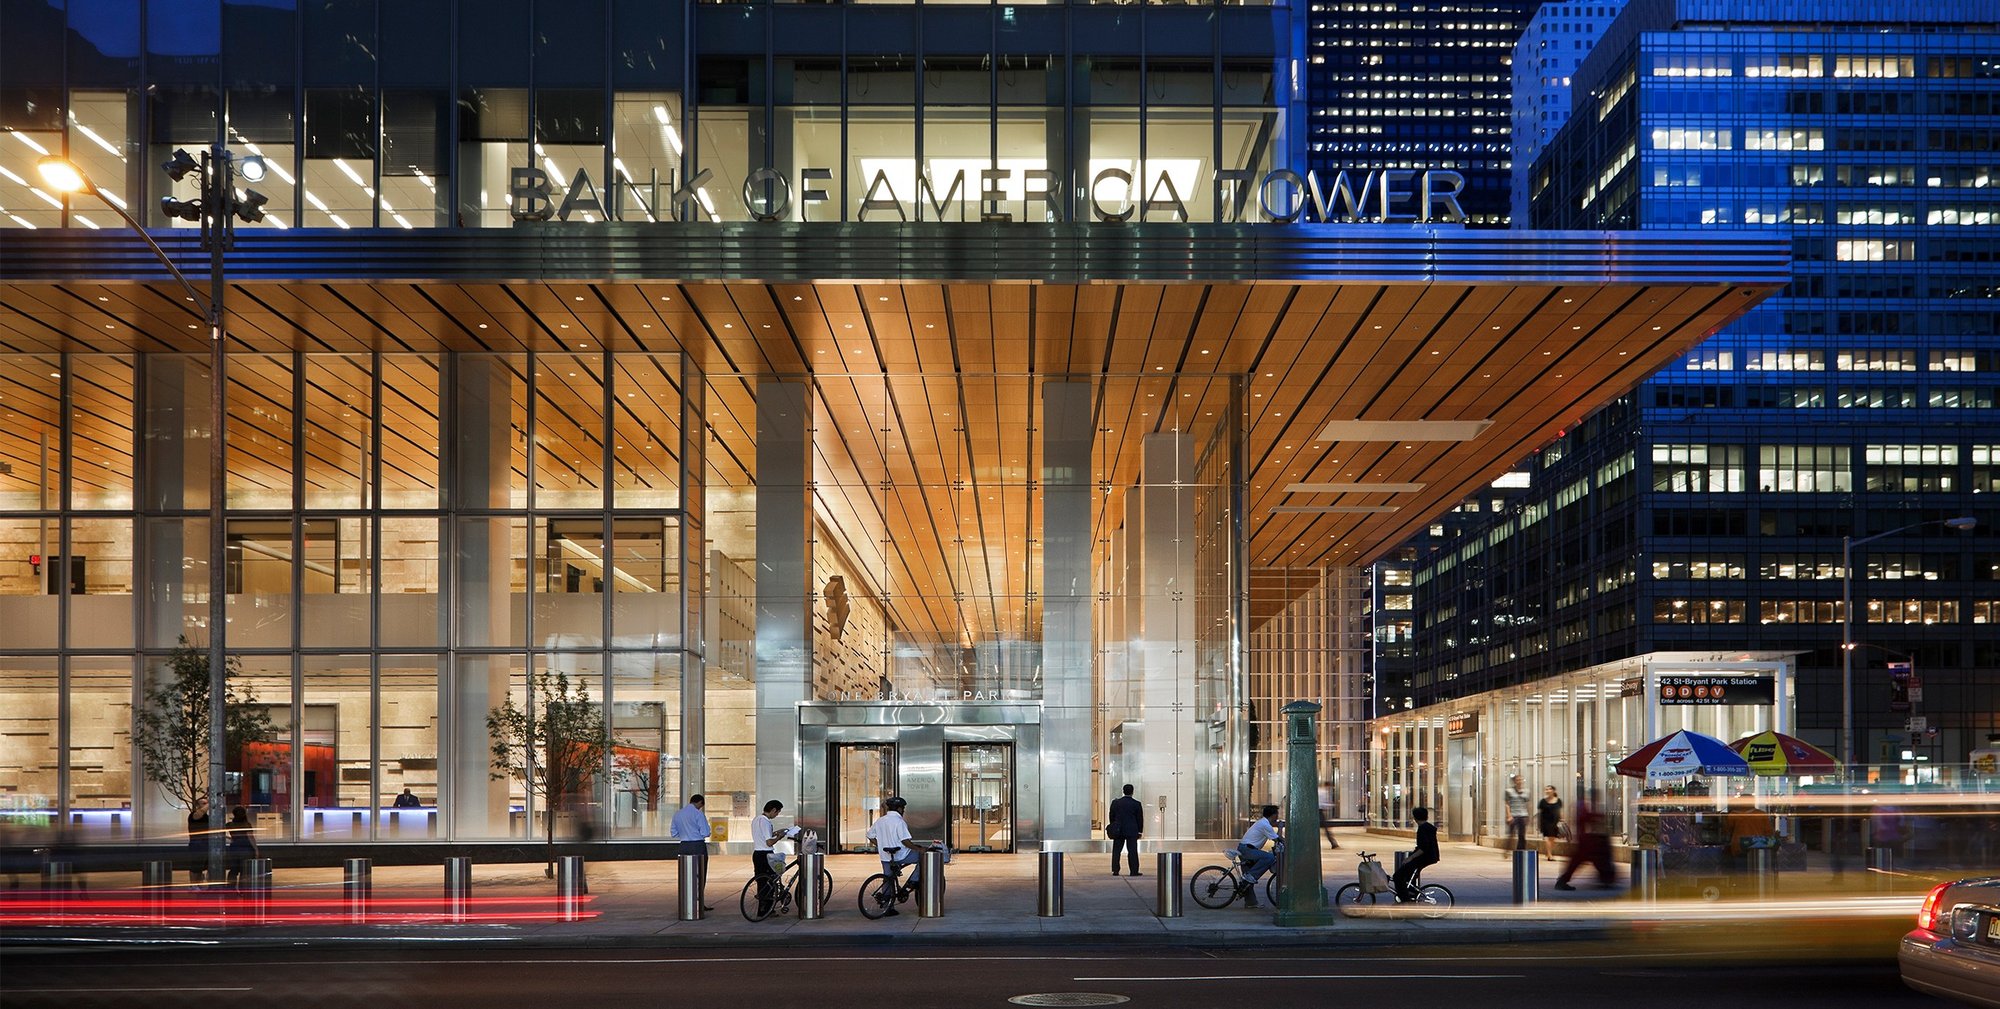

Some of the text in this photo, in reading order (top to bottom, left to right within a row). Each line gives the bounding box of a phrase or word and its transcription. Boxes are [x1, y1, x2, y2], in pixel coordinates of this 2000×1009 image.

[510, 167, 1467, 223] BANK OF AMERICA TOWER
[1673, 678, 1709, 686] St-Bryant
